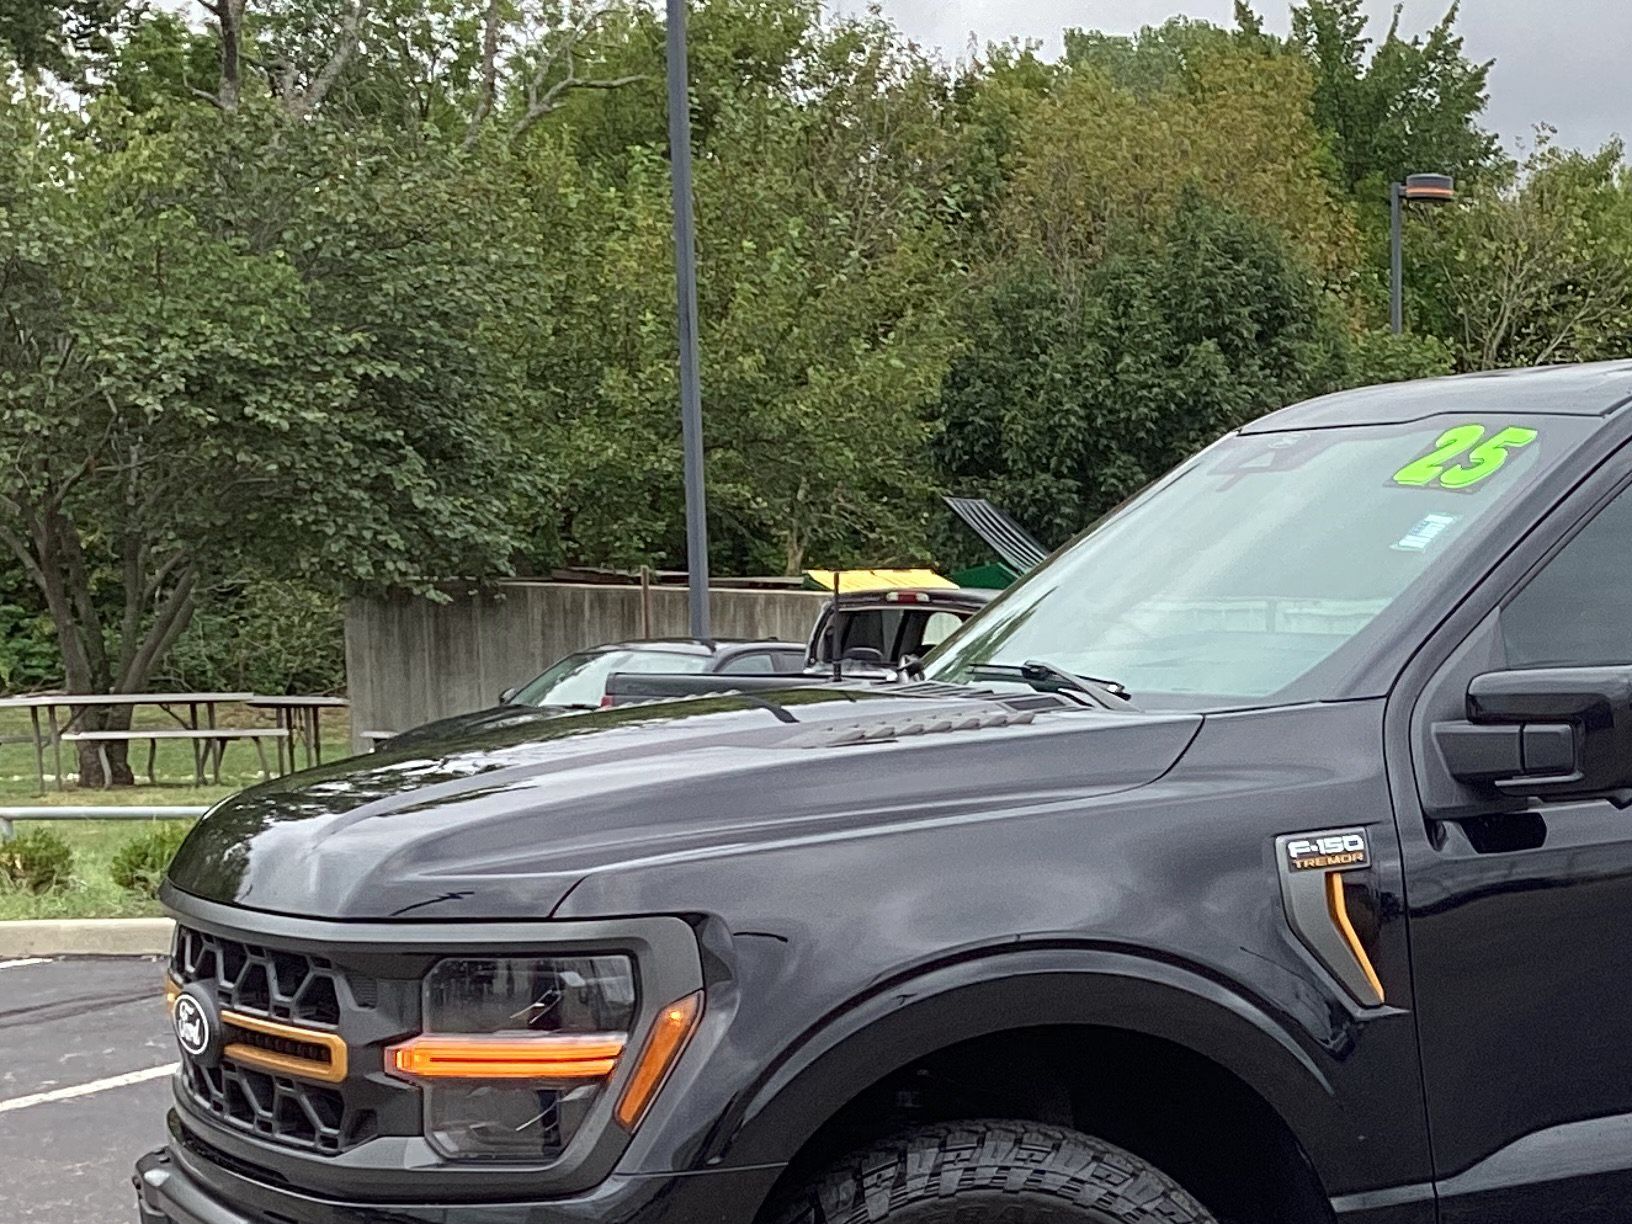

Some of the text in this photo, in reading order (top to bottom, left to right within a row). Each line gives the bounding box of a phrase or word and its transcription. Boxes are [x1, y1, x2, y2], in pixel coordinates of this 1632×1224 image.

[1393, 425, 1538, 488] 25
[1288, 834, 1364, 858] F-150
[1294, 852, 1364, 868] TREMOR
